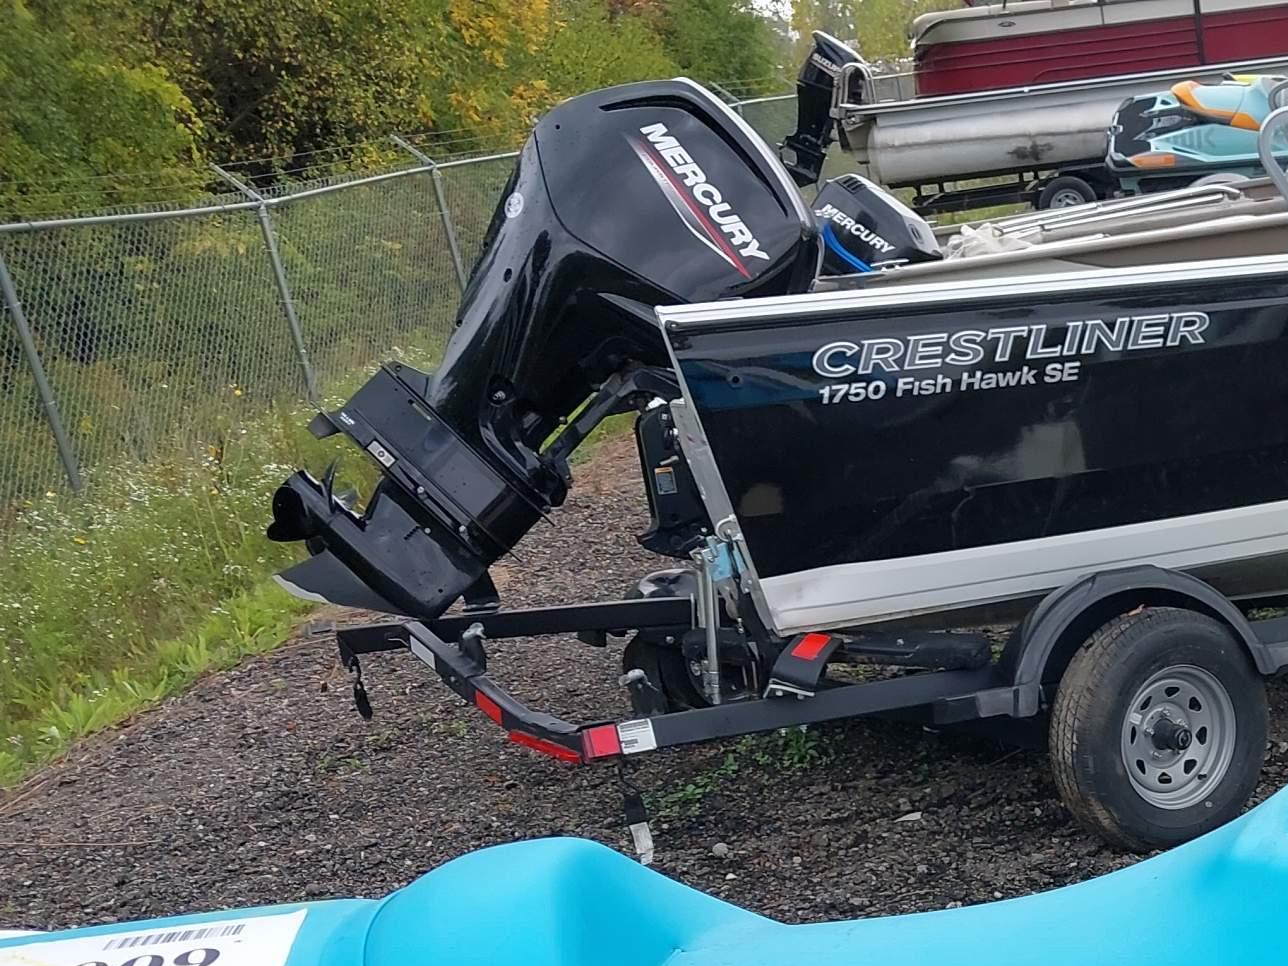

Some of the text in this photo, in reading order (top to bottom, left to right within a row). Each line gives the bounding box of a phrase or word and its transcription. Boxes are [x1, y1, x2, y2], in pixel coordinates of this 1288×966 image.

[640, 123, 770, 260] MERCURY
[820, 204, 896, 253] MERCURY
[812, 311, 1210, 378] CRESTLINER
[818, 361, 1081, 405] 1750 Fish Hawk SE
